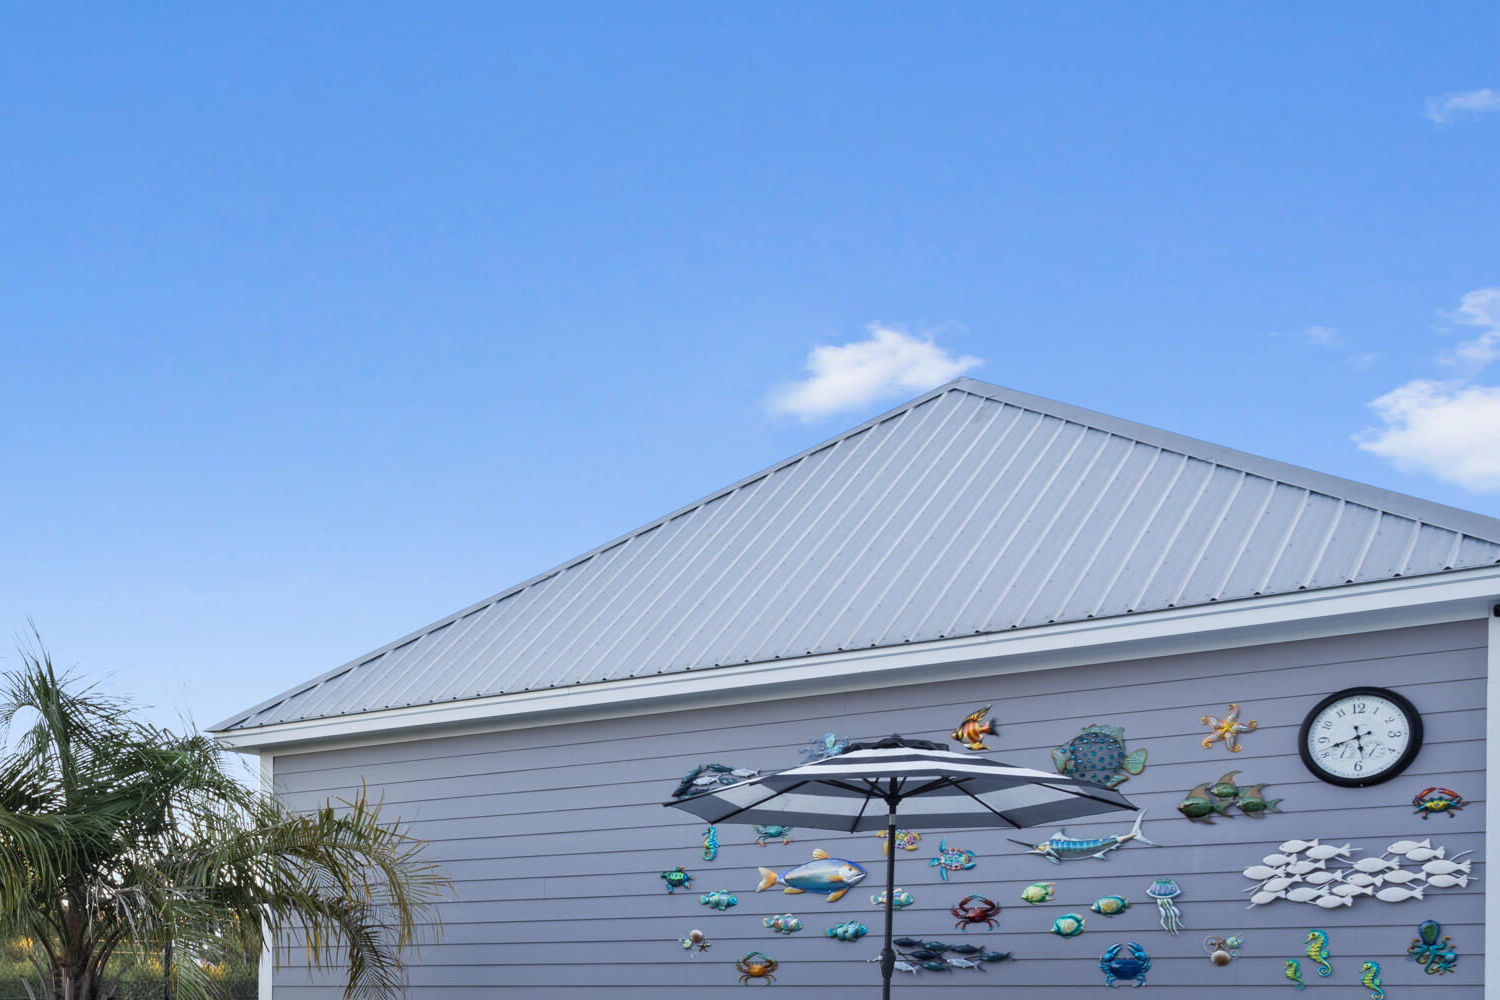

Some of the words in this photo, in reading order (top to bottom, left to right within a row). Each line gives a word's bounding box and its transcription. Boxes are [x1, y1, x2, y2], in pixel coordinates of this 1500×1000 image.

[1352, 702, 1366, 714] 12
[1373, 706, 1380, 715] 1
[1336, 708, 1346, 718] 11
[1384, 716, 1395, 724] 2
[1322, 720, 1333, 730] 10
[1388, 730, 1402, 738] 3
[1317, 736, 1331, 744] 9
[1320, 751, 1331, 759] 8
[1354, 760, 1363, 772] 6
